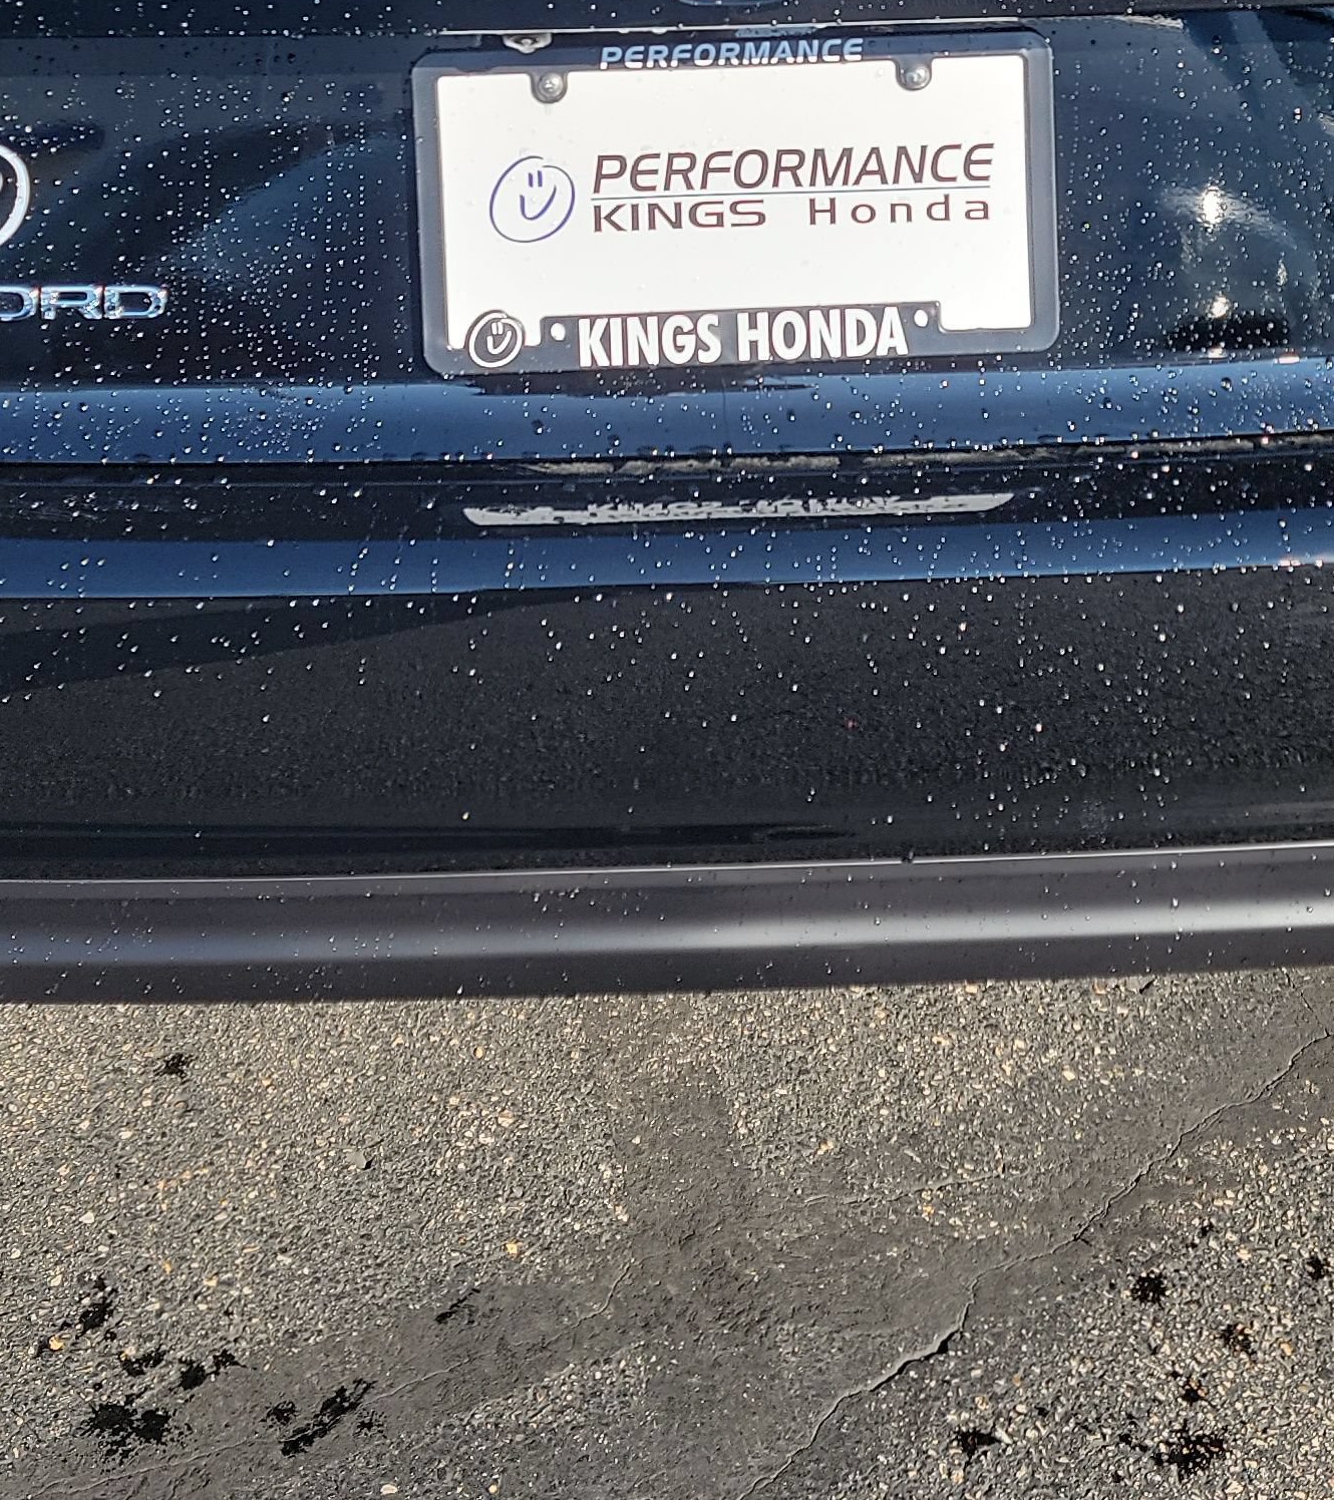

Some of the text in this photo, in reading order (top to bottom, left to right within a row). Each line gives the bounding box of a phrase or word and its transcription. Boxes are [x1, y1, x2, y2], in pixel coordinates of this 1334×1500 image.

[599, 38, 864, 70] PERFORMANCE
[592, 142, 995, 194] PERFORMANCE
[592, 193, 991, 233] KINGS Honda
[578, 306, 909, 369] KINGS HONDA
